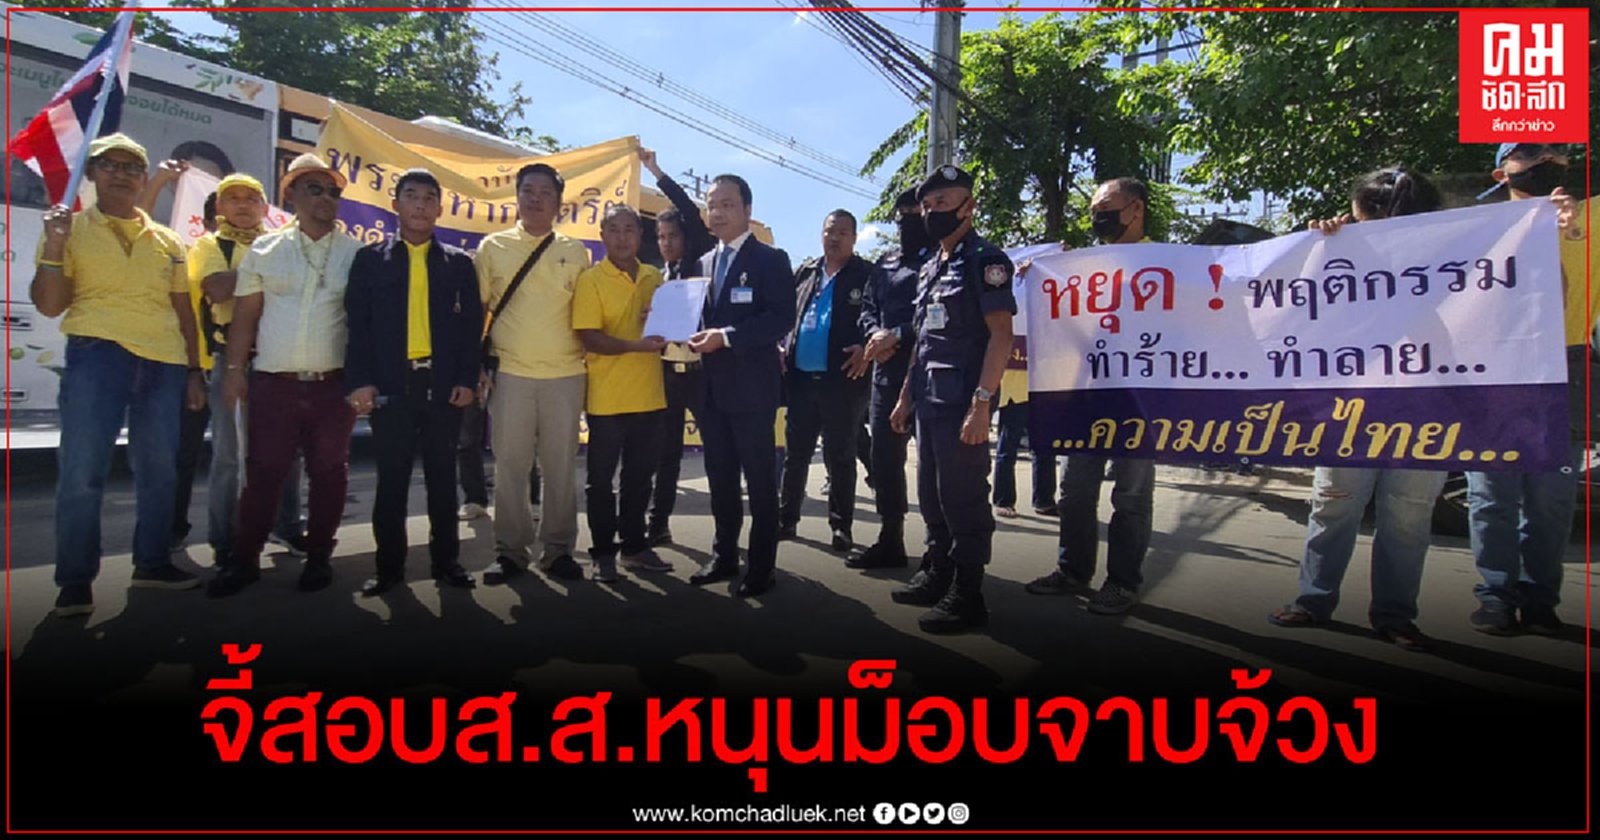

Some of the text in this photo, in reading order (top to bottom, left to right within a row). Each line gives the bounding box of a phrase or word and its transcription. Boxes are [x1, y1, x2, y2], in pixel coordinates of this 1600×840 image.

[1042, 255, 1517, 334] หยุด ! พฤติกรรม
